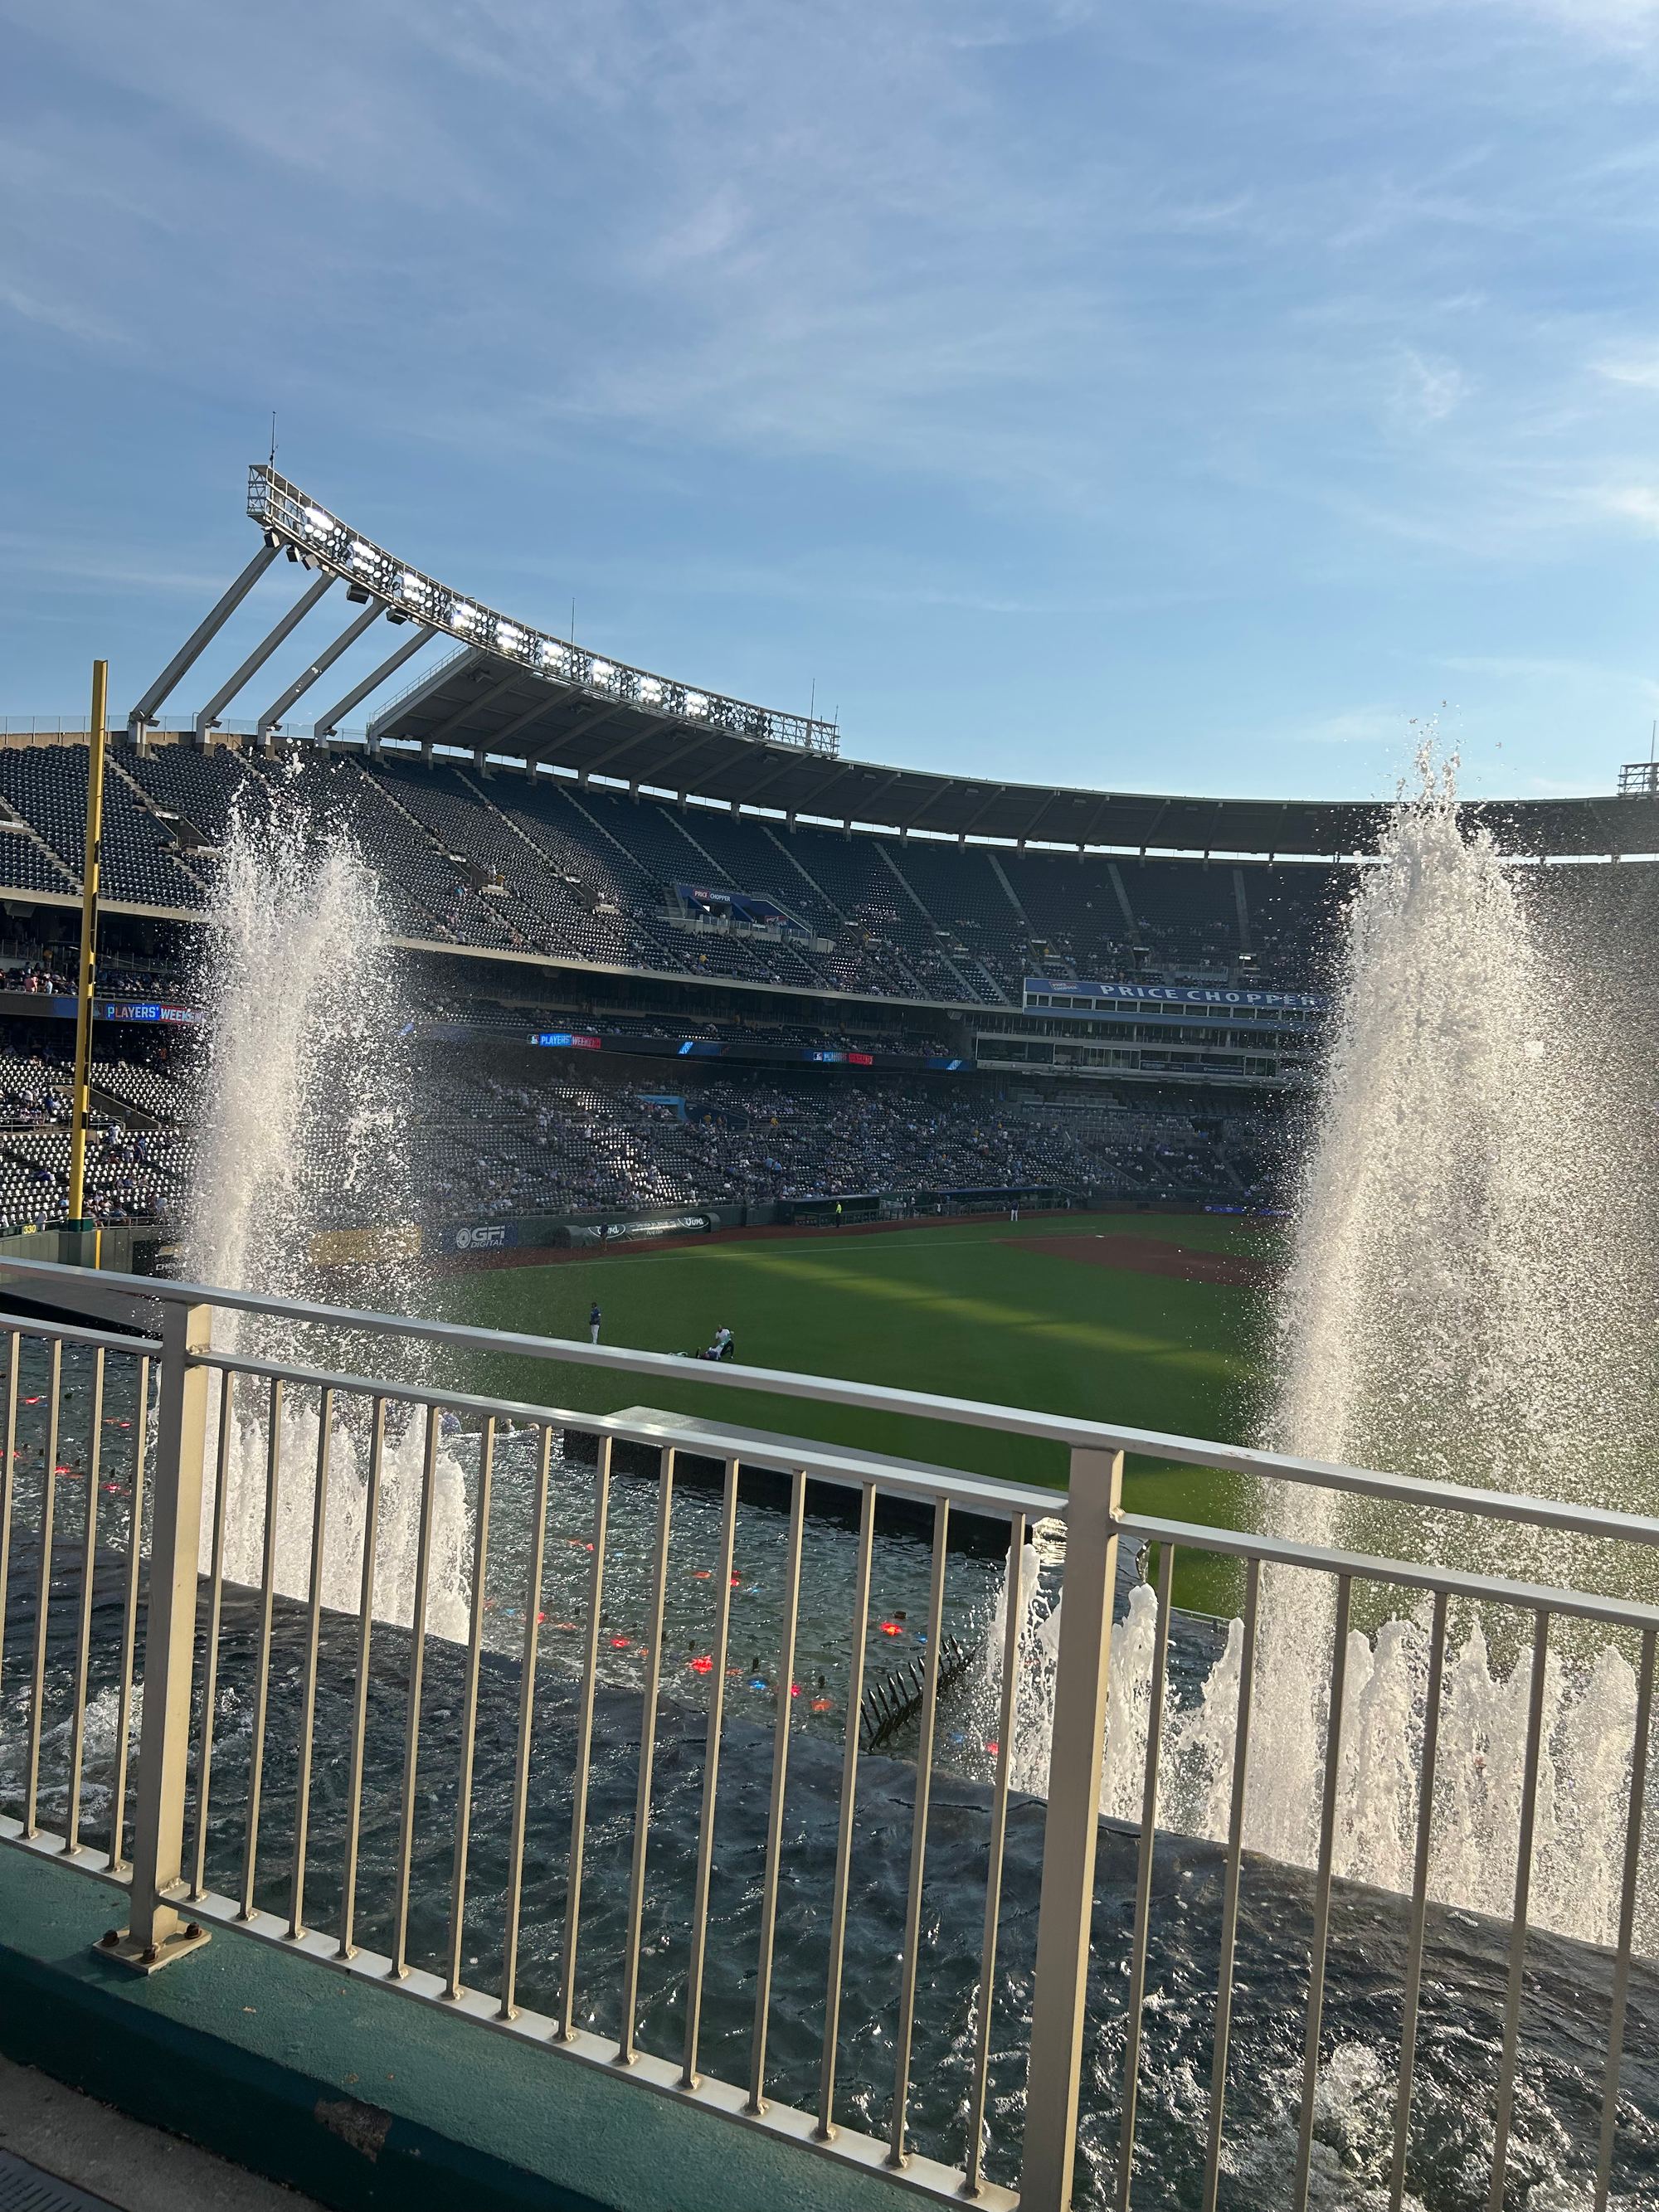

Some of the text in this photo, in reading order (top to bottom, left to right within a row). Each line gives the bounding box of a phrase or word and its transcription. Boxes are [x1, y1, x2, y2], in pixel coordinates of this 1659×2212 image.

[1100, 984, 1316, 1005] PRICE CHOPPER
[107, 1006, 158, 1018] PLAYERS'
[23, 1224, 36, 1234] 330
[596, 1225, 619, 1234] Frd
[470, 1239, 504, 1247] DIGITAL
